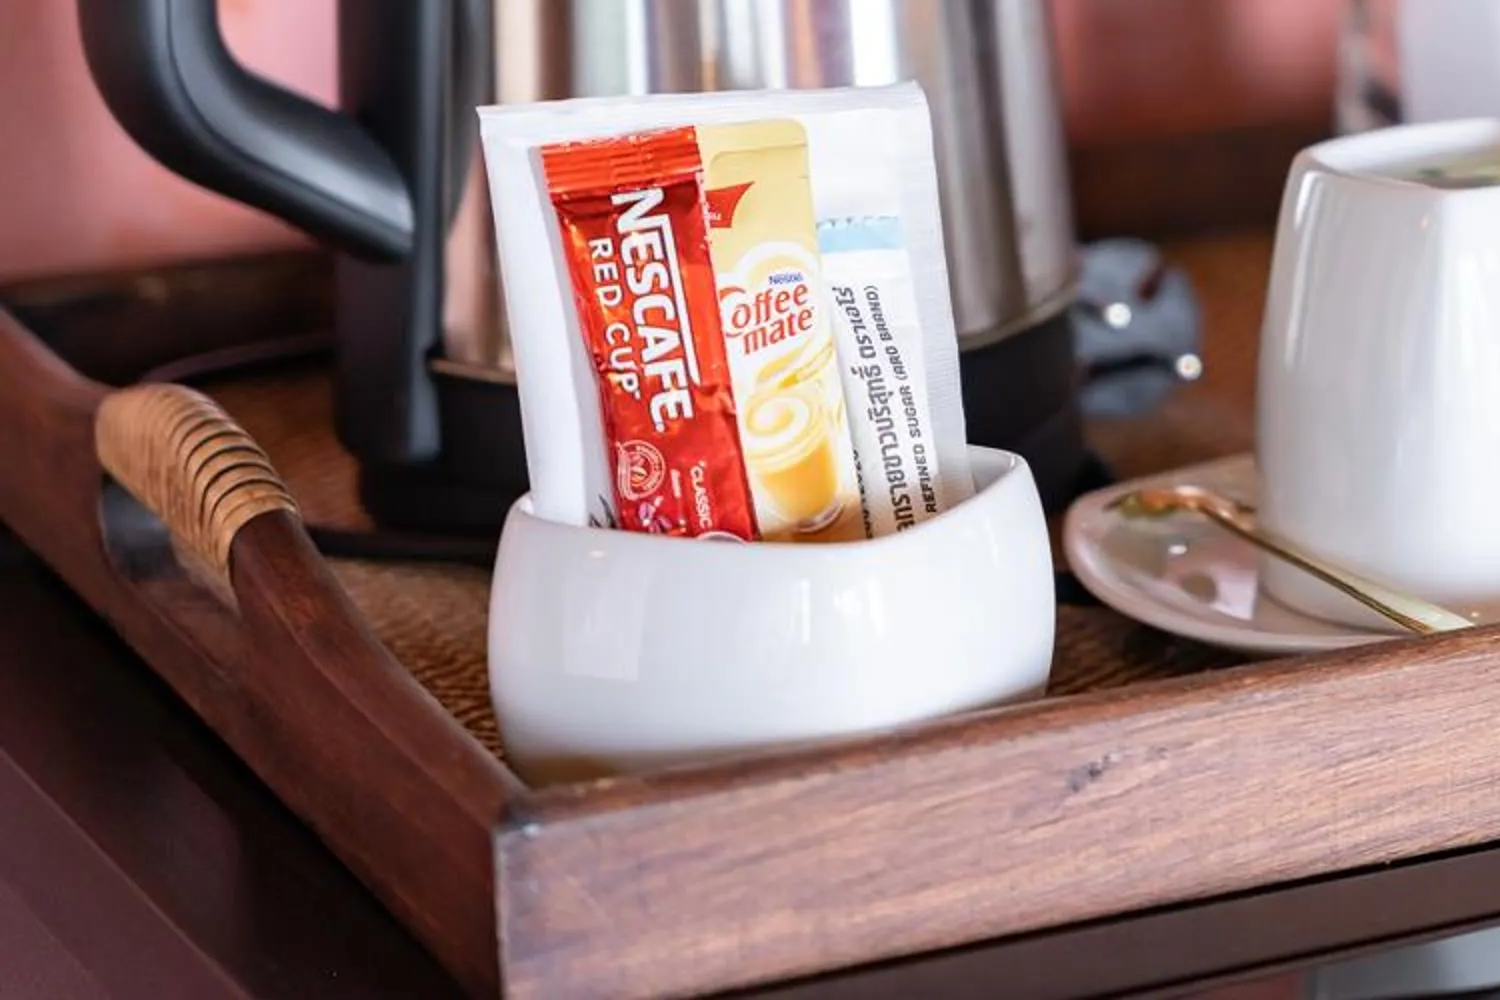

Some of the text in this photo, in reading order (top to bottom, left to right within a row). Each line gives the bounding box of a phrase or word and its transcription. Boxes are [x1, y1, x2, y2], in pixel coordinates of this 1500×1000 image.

[588, 237, 624, 307] RED
[743, 308, 813, 354] mate
[864, 285, 893, 342] BRAND)
[899, 384, 922, 439] SUGAR
[913, 444, 937, 514] REFINED
